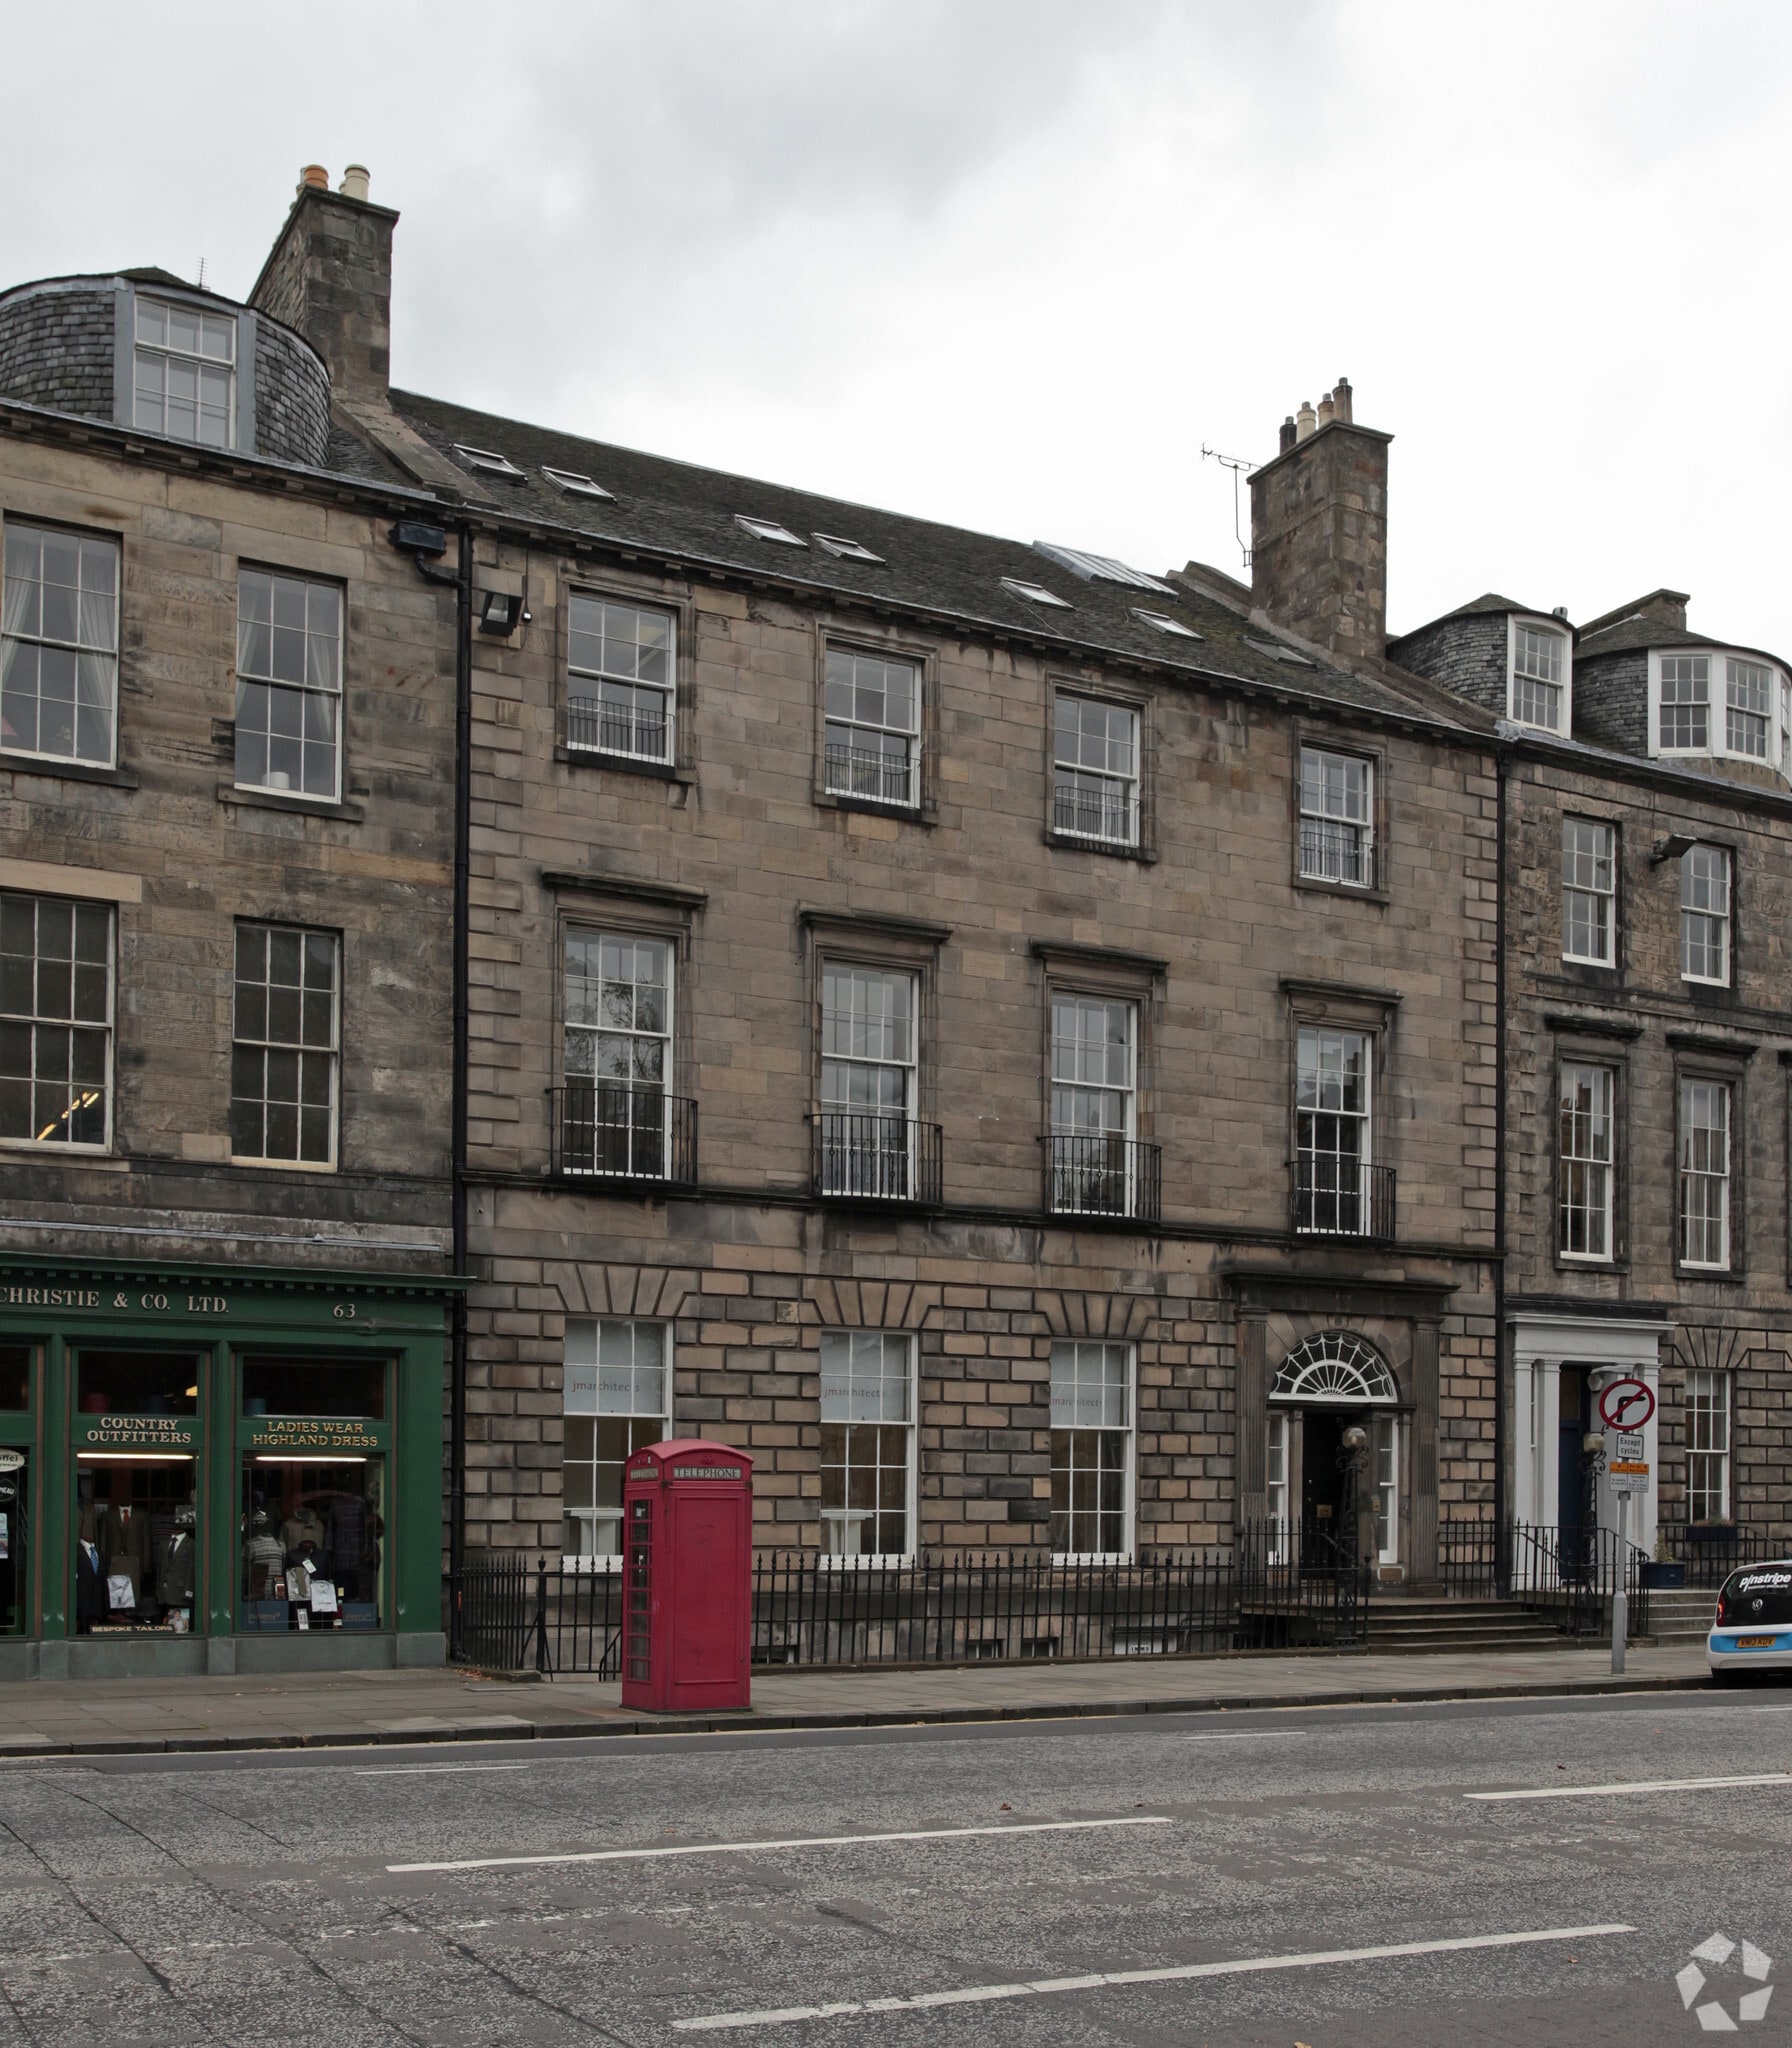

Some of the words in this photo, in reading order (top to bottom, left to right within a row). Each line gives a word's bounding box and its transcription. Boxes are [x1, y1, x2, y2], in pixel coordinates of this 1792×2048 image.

[0, 1287, 99, 1307] CHRISTIE
[112, 1292, 128, 1308] &
[141, 1294, 170, 1310] CO.
[188, 1296, 229, 1313] LTD.
[333, 1303, 356, 1318] 63
[572, 1380, 640, 1392] jmarchitecs
[100, 1417, 178, 1430] COUNTRY
[267, 1421, 319, 1433] LADIES
[322, 1422, 364, 1433] WEAR
[87, 1430, 192, 1443] OUTFITTERS
[252, 1434, 328, 1446] HIGHLAND
[331, 1436, 378, 1446] DRESS
[1620, 1437, 1641, 1446] Except
[676, 1467, 738, 1478] TELEPHONE
[1739, 1572, 1792, 1592] pinstripe
